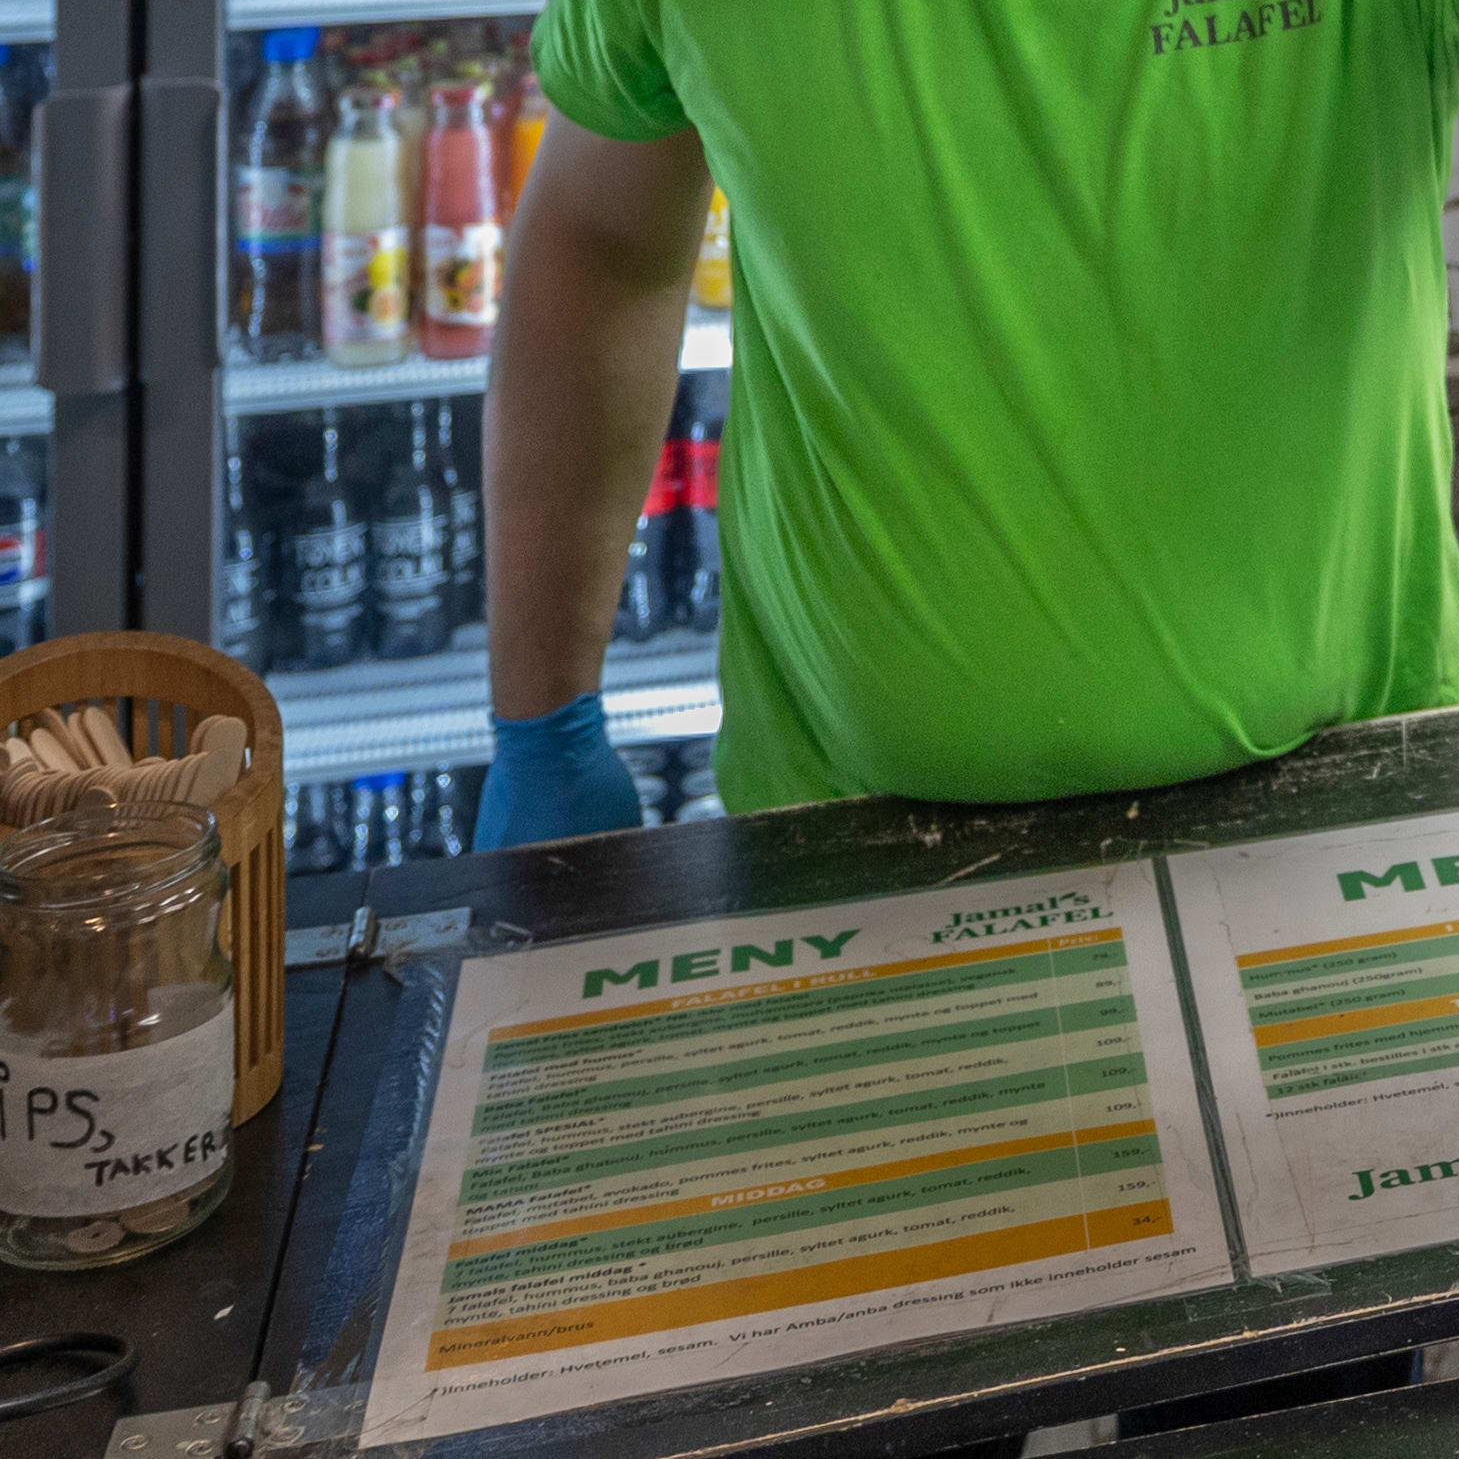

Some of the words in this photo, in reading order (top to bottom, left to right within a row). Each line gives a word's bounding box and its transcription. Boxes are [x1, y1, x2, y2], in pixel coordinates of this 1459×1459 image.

[929, 907, 1115, 944] FALAFEL
[582, 928, 861, 999] MENY
[712, 1177, 826, 1206] MIDDAG
[892, 1289, 964, 1312] dressing
[438, 1319, 594, 1354] Mineralvann/brus
